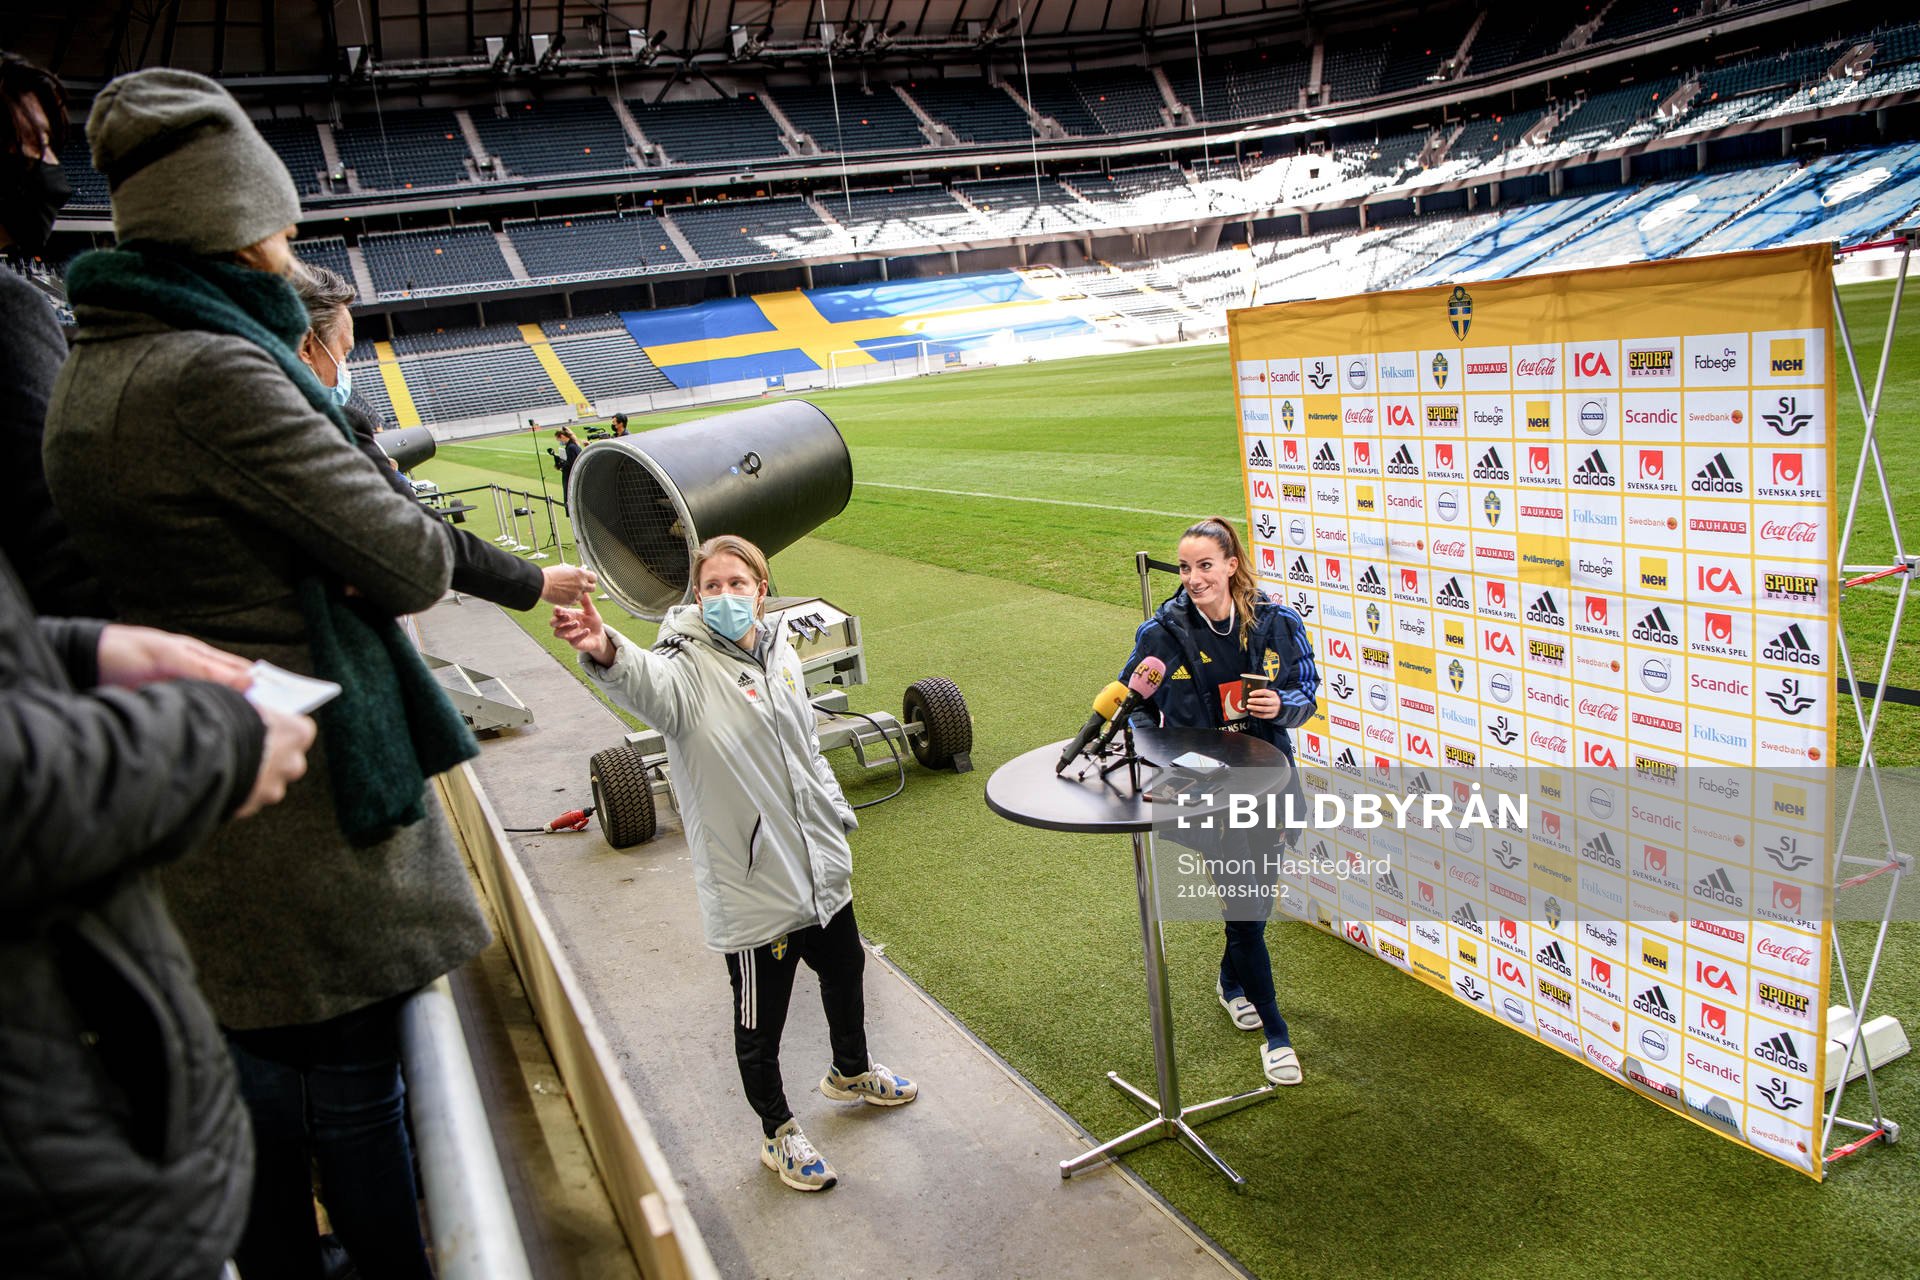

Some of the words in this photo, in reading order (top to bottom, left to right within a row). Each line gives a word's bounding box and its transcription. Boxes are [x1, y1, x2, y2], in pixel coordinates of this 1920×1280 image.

[1316, 362, 1324, 374] SJ
[1467, 364, 1506, 373] BAUHAUS
[1575, 352, 1611, 377] ICA
[1629, 351, 1672, 370] SPORT
[1695, 356, 1736, 371] Fabege
[1271, 371, 1300, 382] Scandic
[1381, 367, 1414, 379] Folksam
[1779, 397, 1795, 415] SJ
[1387, 405, 1414, 426] ICA
[1474, 411, 1503, 425] Fabege
[1626, 410, 1677, 424] Scandic
[1689, 412, 1729, 422] Swedbank
[1250, 457, 1272, 468] adidas
[1313, 460, 1340, 471] adidas
[1388, 464, 1419, 475] adidas
[1473, 467, 1509, 480] adidas
[1573, 472, 1615, 487] adidas
[1254, 480, 1274, 499] ICA
[1282, 484, 1305, 498] SPORT
[1627, 482, 1658, 490] SVENSKA
[1661, 484, 1677, 492] SPEL
[1692, 479, 1742, 493] adidas
[1388, 496, 1422, 508] Scandic
[1262, 514, 1268, 526] SJ
[1521, 507, 1562, 518] BAUHAUS
[1573, 509, 1617, 525] Folksam
[1316, 528, 1346, 541] Scandic
[1690, 520, 1745, 533] BAUHAUS
[1353, 532, 1384, 546] Folksam
[1476, 548, 1514, 560] BAUHAUS
[1579, 560, 1612, 577] Fabege
[1289, 572, 1313, 583] adidas
[1699, 566, 1742, 594] ICA
[1765, 574, 1817, 596] SPORT
[1357, 583, 1386, 596] adidas
[1299, 592, 1306, 604] SJ
[1394, 593, 1414, 602] SVENSKA
[1415, 596, 1428, 604] SPEL
[1436, 596, 1469, 609] adidas
[1479, 608, 1501, 616] SVENSKA
[1502, 611, 1516, 619] SPEL
[1527, 612, 1564, 626] adidas
[1575, 625, 1602, 634] SVENSKA
[1604, 629, 1620, 637] SPEL
[1632, 628, 1678, 645] adidas
[1329, 639, 1352, 661] ICA
[1485, 630, 1515, 656] ICA
[1529, 640, 1564, 658] SPORT
[1692, 643, 1726, 654] SVENSKA
[1728, 648, 1748, 657] SPEL
[1763, 649, 1820, 665] adidas
[1338, 674, 1346, 686] SJ
[1643, 670, 1667, 678] VOLVO
[1691, 675, 1748, 696] Scandic
[1782, 679, 1798, 695] SJ
[1401, 699, 1434, 713] BAUHAUS
[1528, 688, 1569, 708] Scandic
[1331, 716, 1360, 731] BAUHAUS
[1442, 709, 1476, 727] Folksam
[1498, 716, 1508, 729] SJ
[1633, 713, 1681, 732] BAUHAUS
[1693, 725, 1747, 748] Folksam
[1408, 733, 1433, 758] ICA
[1446, 745, 1475, 765] SPORT
[1584, 741, 1617, 770] ICA
[1335, 760, 1361, 777] adidas
[1636, 757, 1677, 781] SPORT
[1699, 777, 1739, 799] Fabege
[1632, 807, 1681, 831] Scandic
[1502, 841, 1511, 853] SJ
[1781, 837, 1796, 852] SJ
[1582, 848, 1621, 869] adidas
[1633, 870, 1662, 885] SVENSKA
[1663, 880, 1680, 891] SPEL
[1376, 884, 1403, 899] adidas
[1693, 886, 1743, 908] adidas
[1452, 916, 1483, 935] adidas
[1758, 908, 1795, 925] SVENSKA
[1798, 919, 1816, 930] SPEL
[1347, 923, 1368, 947] ICA
[1586, 924, 1617, 946] Fabege
[1691, 919, 1744, 942] BAUHAUS
[1497, 958, 1525, 988] ICA
[1536, 954, 1571, 977] adidas
[1465, 976, 1474, 989] SJ
[1697, 961, 1737, 996] ICA
[1539, 979, 1571, 1005] SPORT
[1581, 979, 1607, 994] SVENSKA
[1608, 991, 1622, 1002] SPEL
[1759, 984, 1809, 1013] SPORT
[1633, 998, 1676, 1024] adidas
[1539, 1019, 1579, 1046] Scandic
[1688, 1026, 1719, 1042] SVENSKA
[1721, 1039, 1739, 1051] SPEL
[1687, 1053, 1740, 1084] Scandic
[1754, 1048, 1808, 1073] adidas
[1772, 1079, 1787, 1094] SJ
[1752, 1127, 1795, 1147] Swedbank
